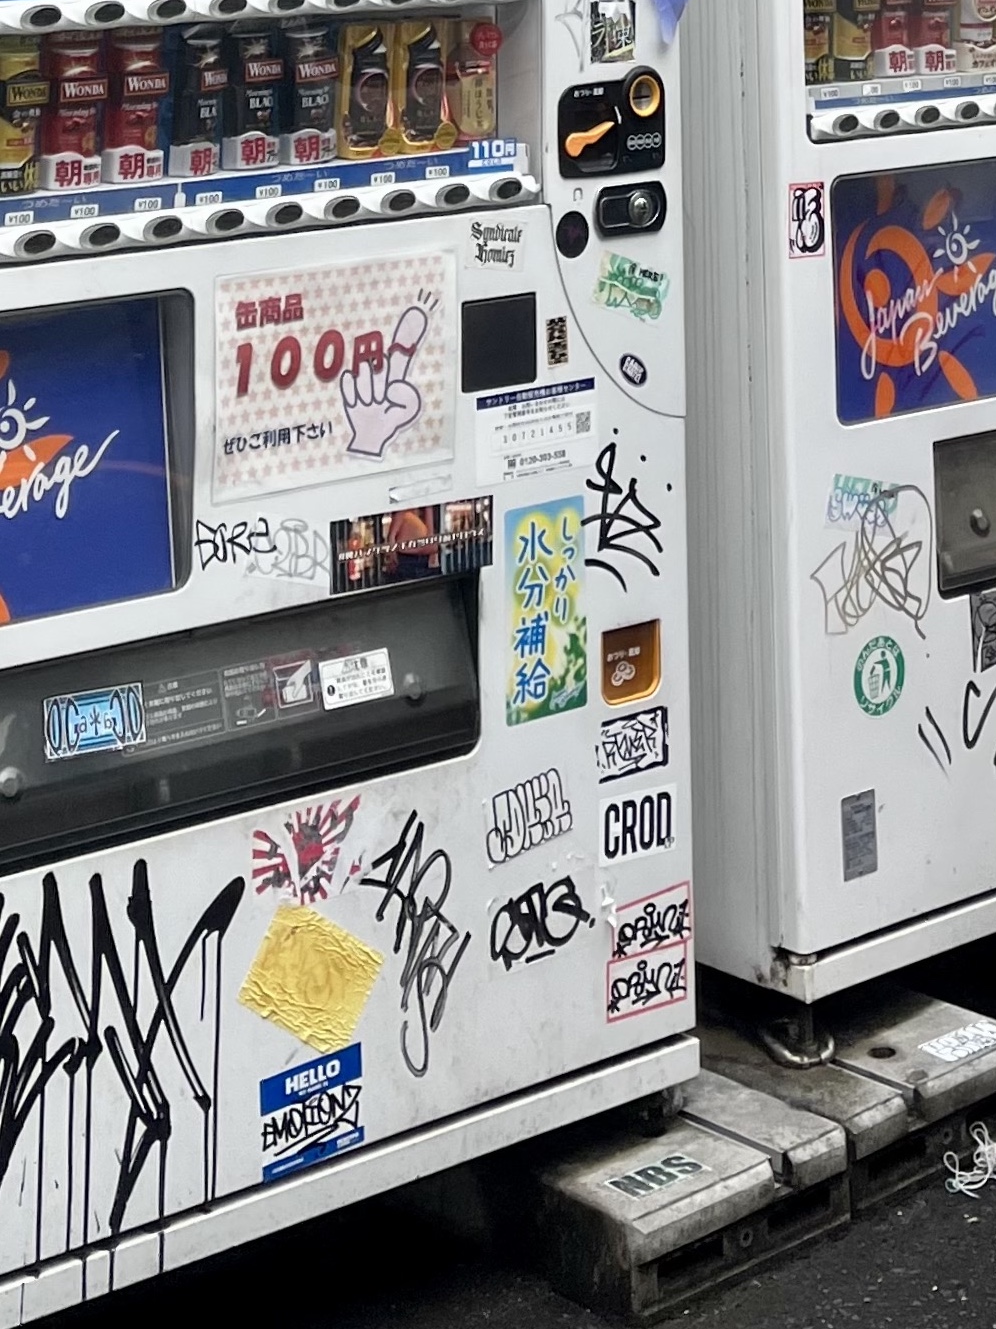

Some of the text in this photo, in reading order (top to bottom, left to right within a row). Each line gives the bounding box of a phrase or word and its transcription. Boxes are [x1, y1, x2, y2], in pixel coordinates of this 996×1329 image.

[248, 61, 282, 78] WONDA
[300, 62, 336, 77] WONDA
[888, 50, 908, 73] 朝
[925, 50, 945, 73] 朝
[64, 81, 105, 97] WONDA
[127, 75, 167, 91] WONDA
[241, 137, 266, 165] 朝
[293, 135, 319, 161] 朝
[471, 141, 516, 158] 110円
[55, 160, 82, 187] 朝
[119, 152, 145, 180] 朝
[235, 292, 305, 331] 缶商品
[861, 267, 945, 380] Japan
[223, 420, 333, 456] ぜひご利用下さい
[554, 516, 578, 622] しっかり
[512, 521, 554, 705] 水分補給
[604, 791, 672, 860] CROD
[285, 1058, 341, 1096] HELLO
